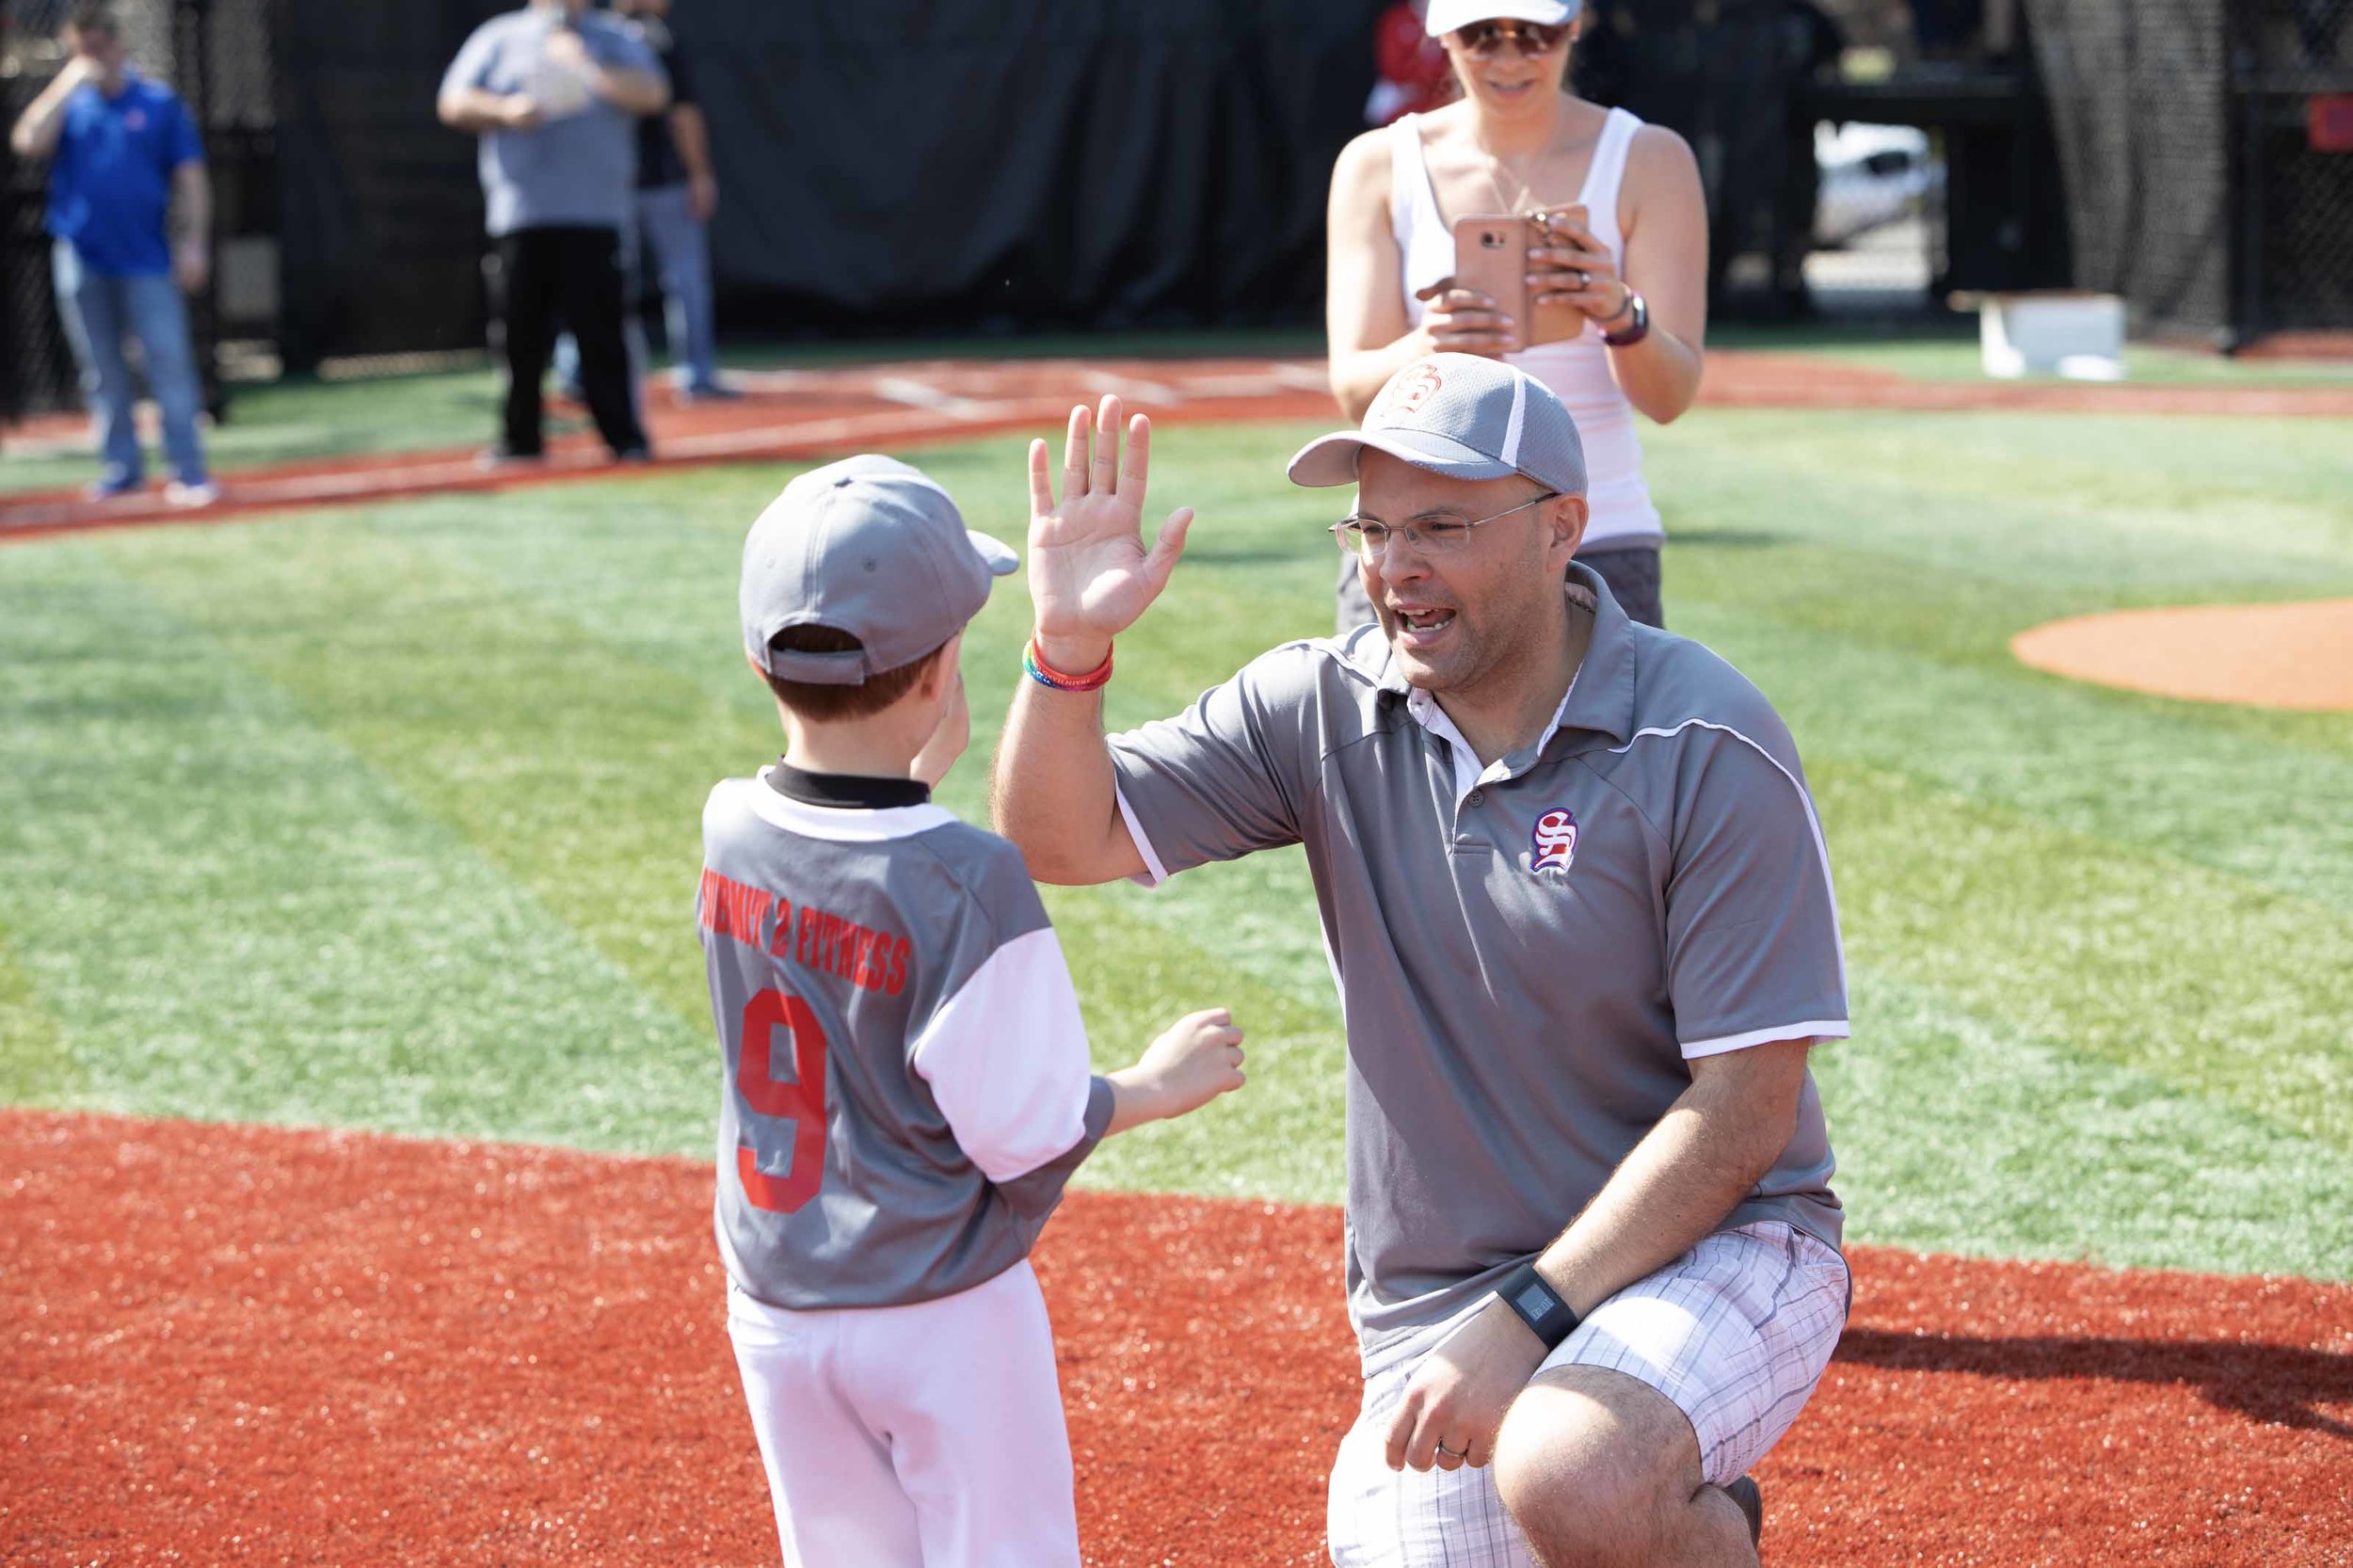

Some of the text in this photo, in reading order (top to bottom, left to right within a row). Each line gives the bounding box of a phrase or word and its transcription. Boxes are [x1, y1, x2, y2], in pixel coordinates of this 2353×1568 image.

[1530, 807, 1578, 873] S
[769, 897, 792, 959] 2
[795, 905, 911, 997] FITNESS
[736, 987, 827, 1215] 9
